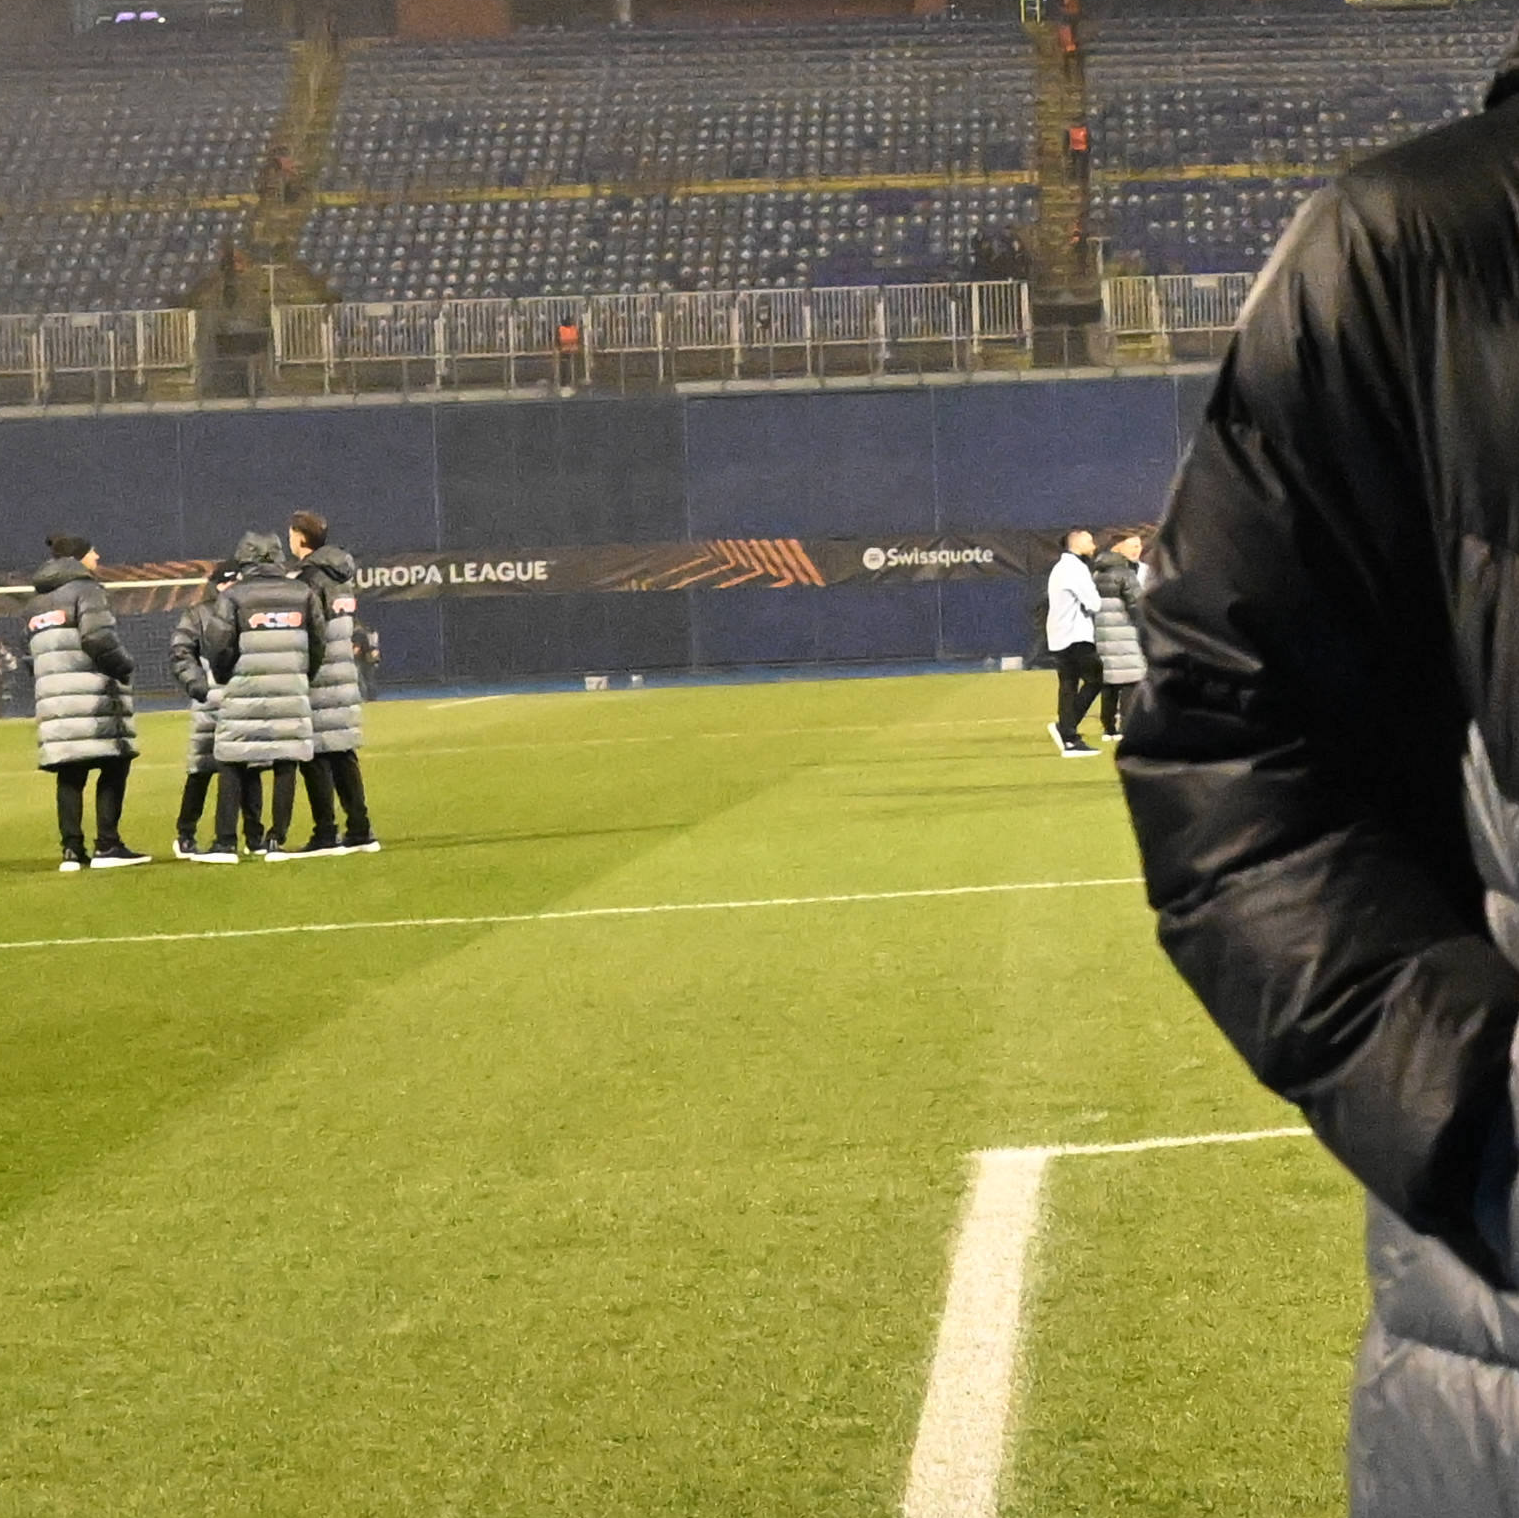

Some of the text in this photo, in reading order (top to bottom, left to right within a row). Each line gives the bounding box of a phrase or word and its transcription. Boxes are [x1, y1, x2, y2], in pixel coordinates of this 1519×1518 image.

[887, 546, 994, 569] Swissquote
[350, 560, 549, 588] UROPA LEAGUE
